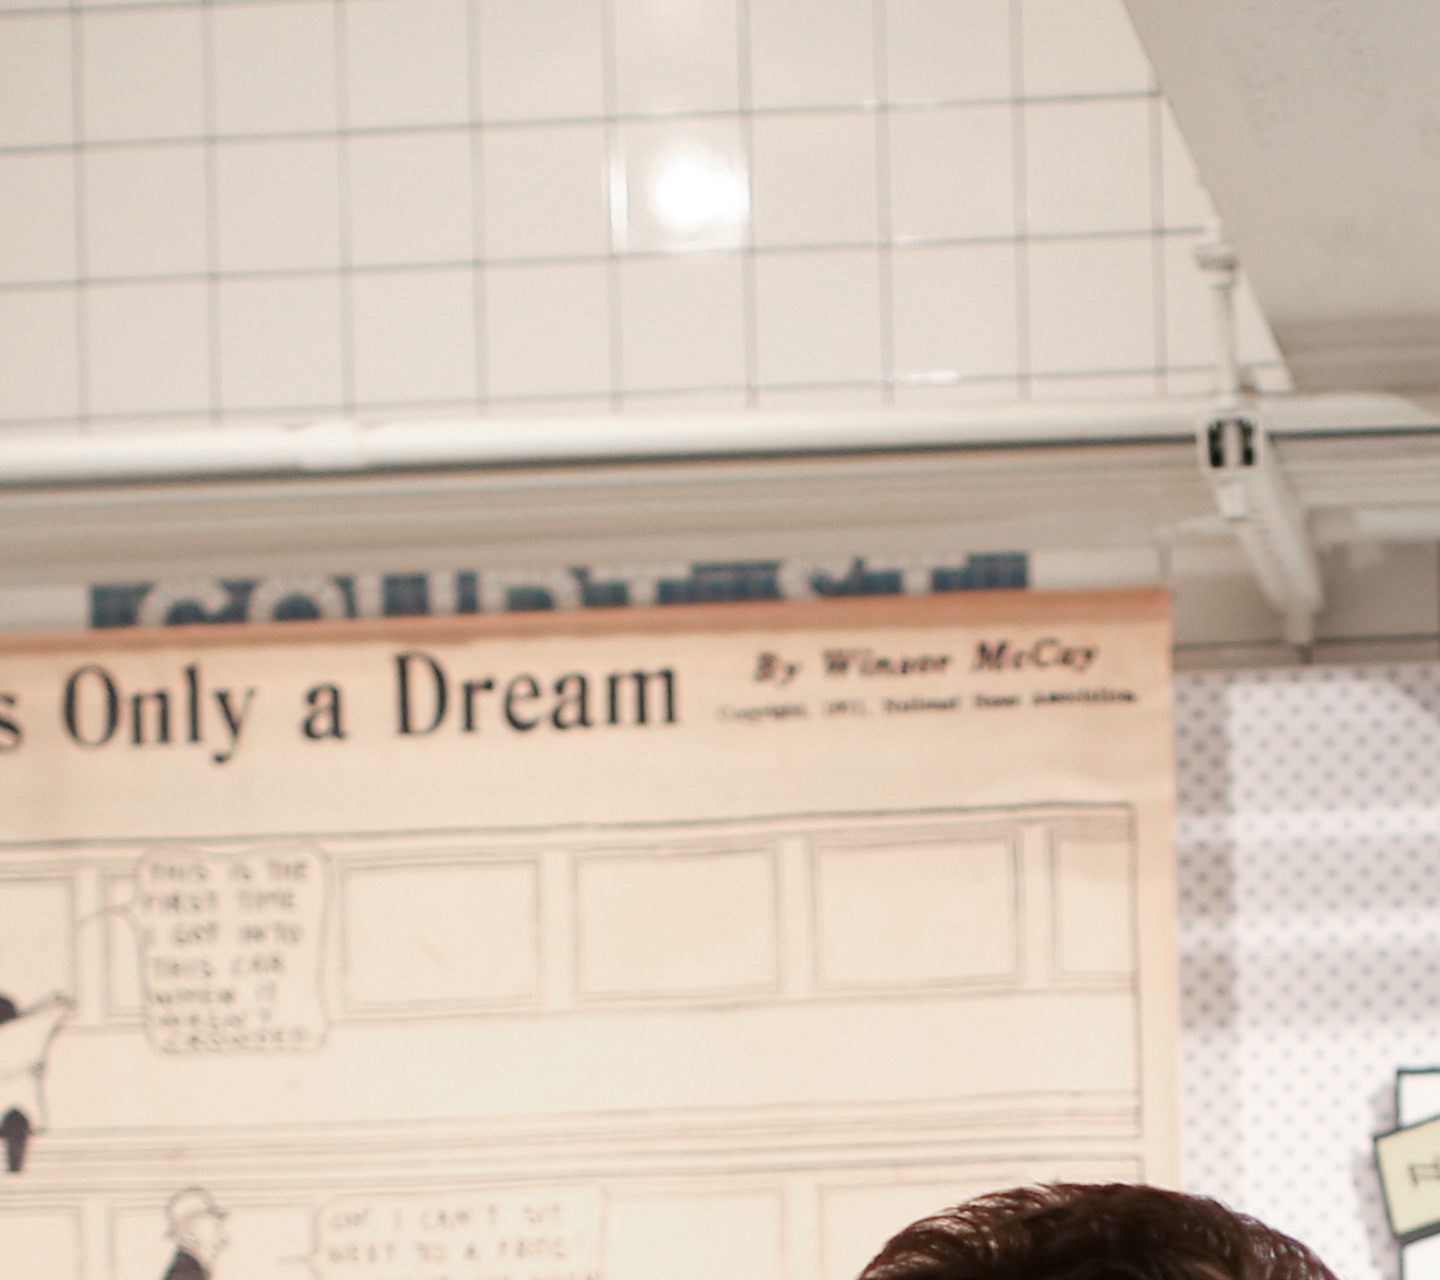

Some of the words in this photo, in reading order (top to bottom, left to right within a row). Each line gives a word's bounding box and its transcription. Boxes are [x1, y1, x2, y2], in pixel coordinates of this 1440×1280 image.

[754, 651, 800, 686] By
[822, 645, 953, 677] Winsor
[971, 635, 1101, 673] McCay
[64, 662, 255, 764] Only
[301, 681, 348, 741] a
[393, 649, 679, 738] Dream
[267, 856, 308, 881] THE
